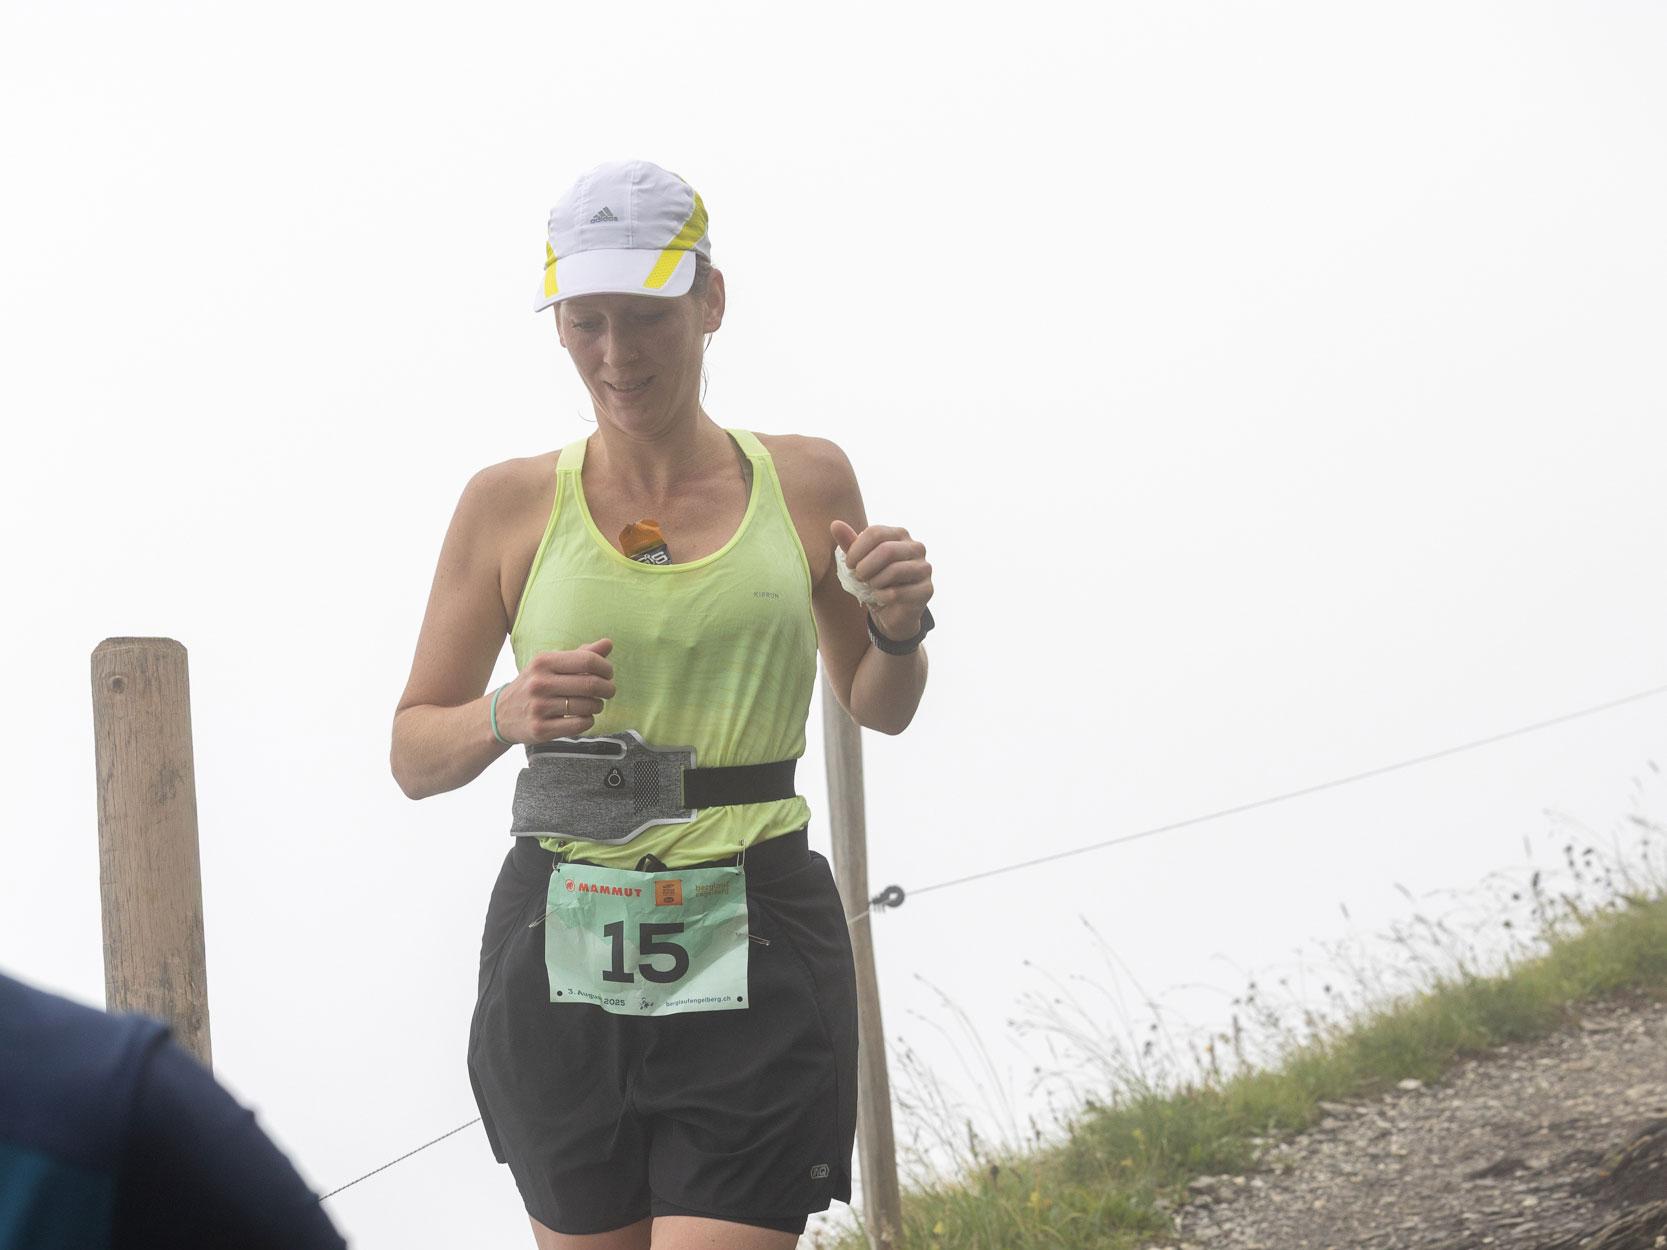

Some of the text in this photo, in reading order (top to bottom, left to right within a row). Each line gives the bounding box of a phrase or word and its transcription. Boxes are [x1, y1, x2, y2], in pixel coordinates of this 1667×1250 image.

[590, 215, 619, 224] adidas
[753, 591, 780, 599] KIPRUN
[578, 882, 642, 897] MAMMUT
[602, 920, 690, 984] 15
[603, 998, 626, 1007] 2025
